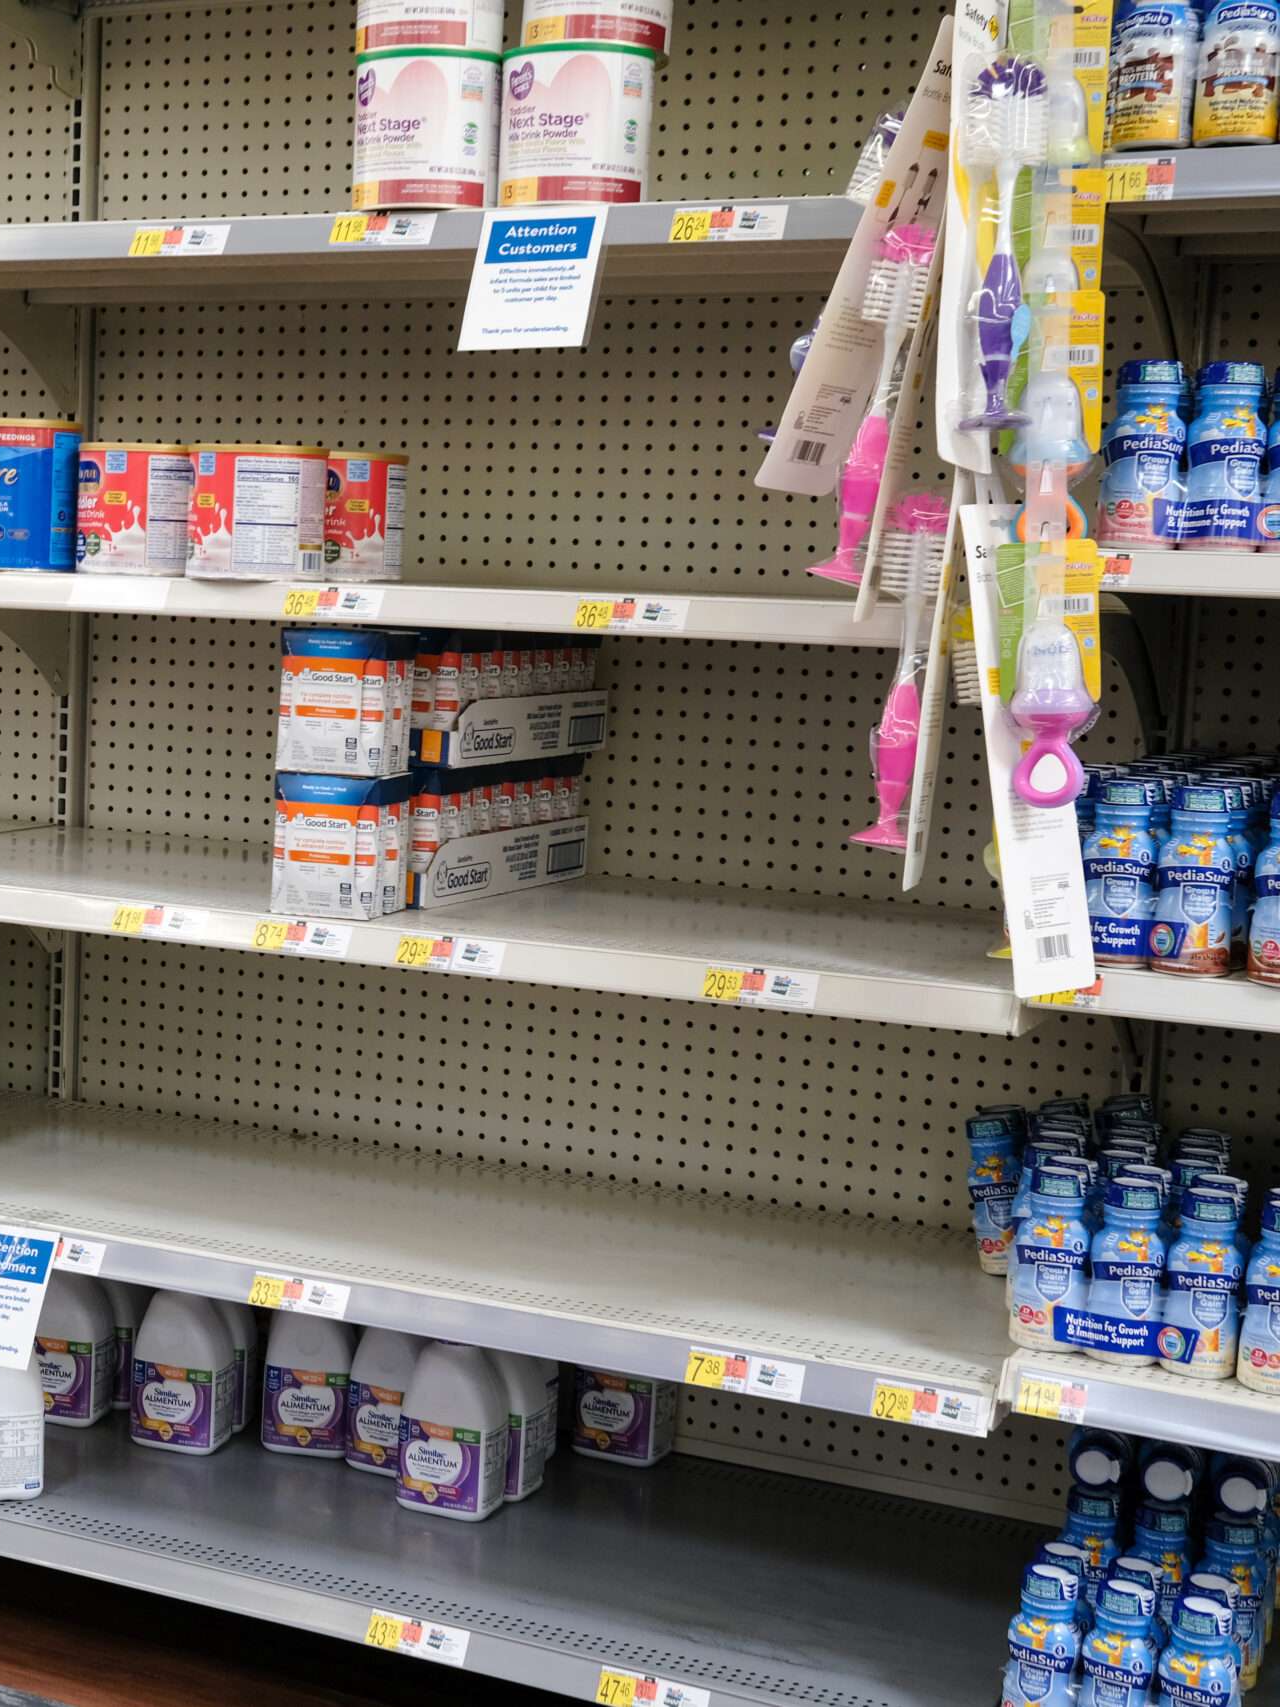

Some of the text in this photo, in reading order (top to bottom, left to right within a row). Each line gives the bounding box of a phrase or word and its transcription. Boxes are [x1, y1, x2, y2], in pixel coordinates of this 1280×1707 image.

[379, 118, 421, 133] Stage
[509, 113, 585, 129] Next Stage
[383, 134, 415, 143] Powder
[543, 129, 578, 138] Powder
[505, 223, 577, 239] Attention
[498, 242, 577, 257] Customers
[1123, 437, 1184, 454] PediaSure
[1220, 503, 1250, 517] Growth
[1212, 514, 1247, 529] Support
[311, 673, 354, 683] Good Start
[473, 733, 513, 751] Good Start
[305, 818, 347, 830] Good Start
[1090, 862, 1150, 878] PediaSure
[1168, 870, 1231, 885] PediaSure
[447, 868, 488, 890] Good Start
[1108, 923, 1141, 936] Growth
[1101, 934, 1137, 948] Support
[1024, 1249, 1084, 1265] PediaSure
[1109, 1265, 1162, 1278] PediaSur
[1065, 1312, 1149, 1337] Nutrition for Growth
[1076, 1325, 1110, 1343] Immune
[1110, 1333, 1145, 1349] Support
[40, 1368, 72, 1380] MENTUM
[144, 1395, 192, 1408] ALIMENTUM
[280, 1400, 332, 1413] ALIMENTUM
[358, 1417, 402, 1431] ALIMENTU
[418, 1446, 446, 1458] Similac
[408, 1453, 459, 1468] ALIMENTUM
[1009, 1642, 1067, 1669] PediaSure
[1084, 1660, 1146, 1686] PediaSure
[1160, 1680, 1224, 1704] PediaSure
